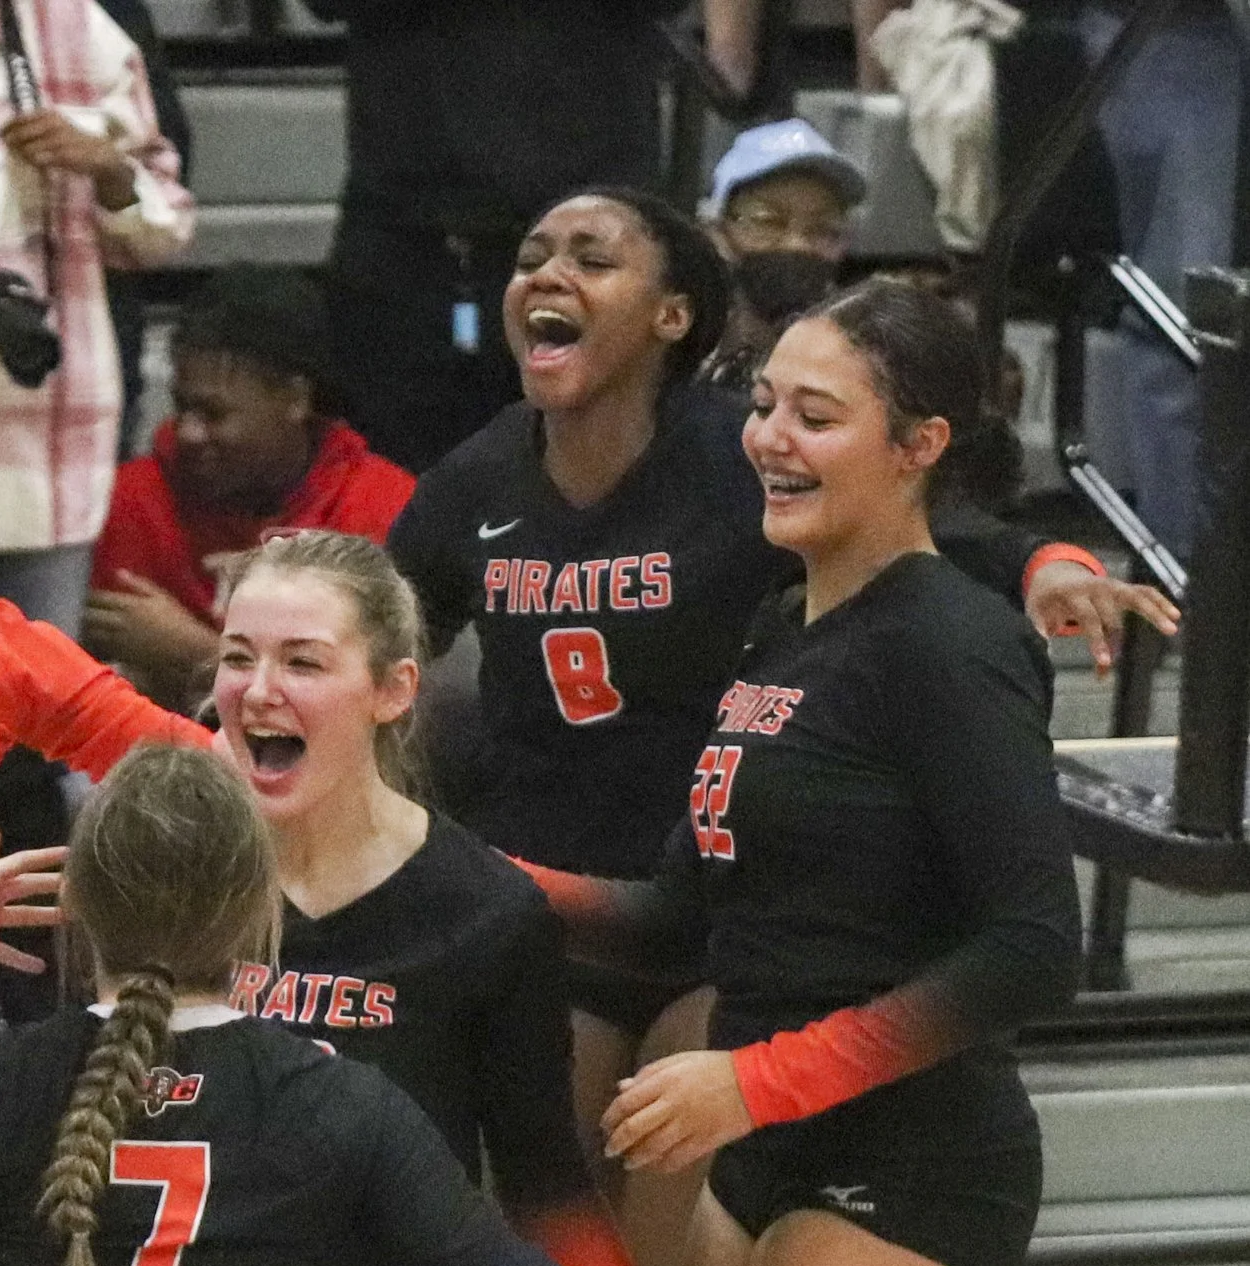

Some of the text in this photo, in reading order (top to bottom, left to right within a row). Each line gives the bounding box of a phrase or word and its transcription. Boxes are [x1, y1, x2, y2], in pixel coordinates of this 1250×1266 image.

[484, 551, 672, 613] PIRATES
[541, 626, 623, 725] 8
[690, 745, 743, 861] 22
[229, 960, 397, 1027] RATES
